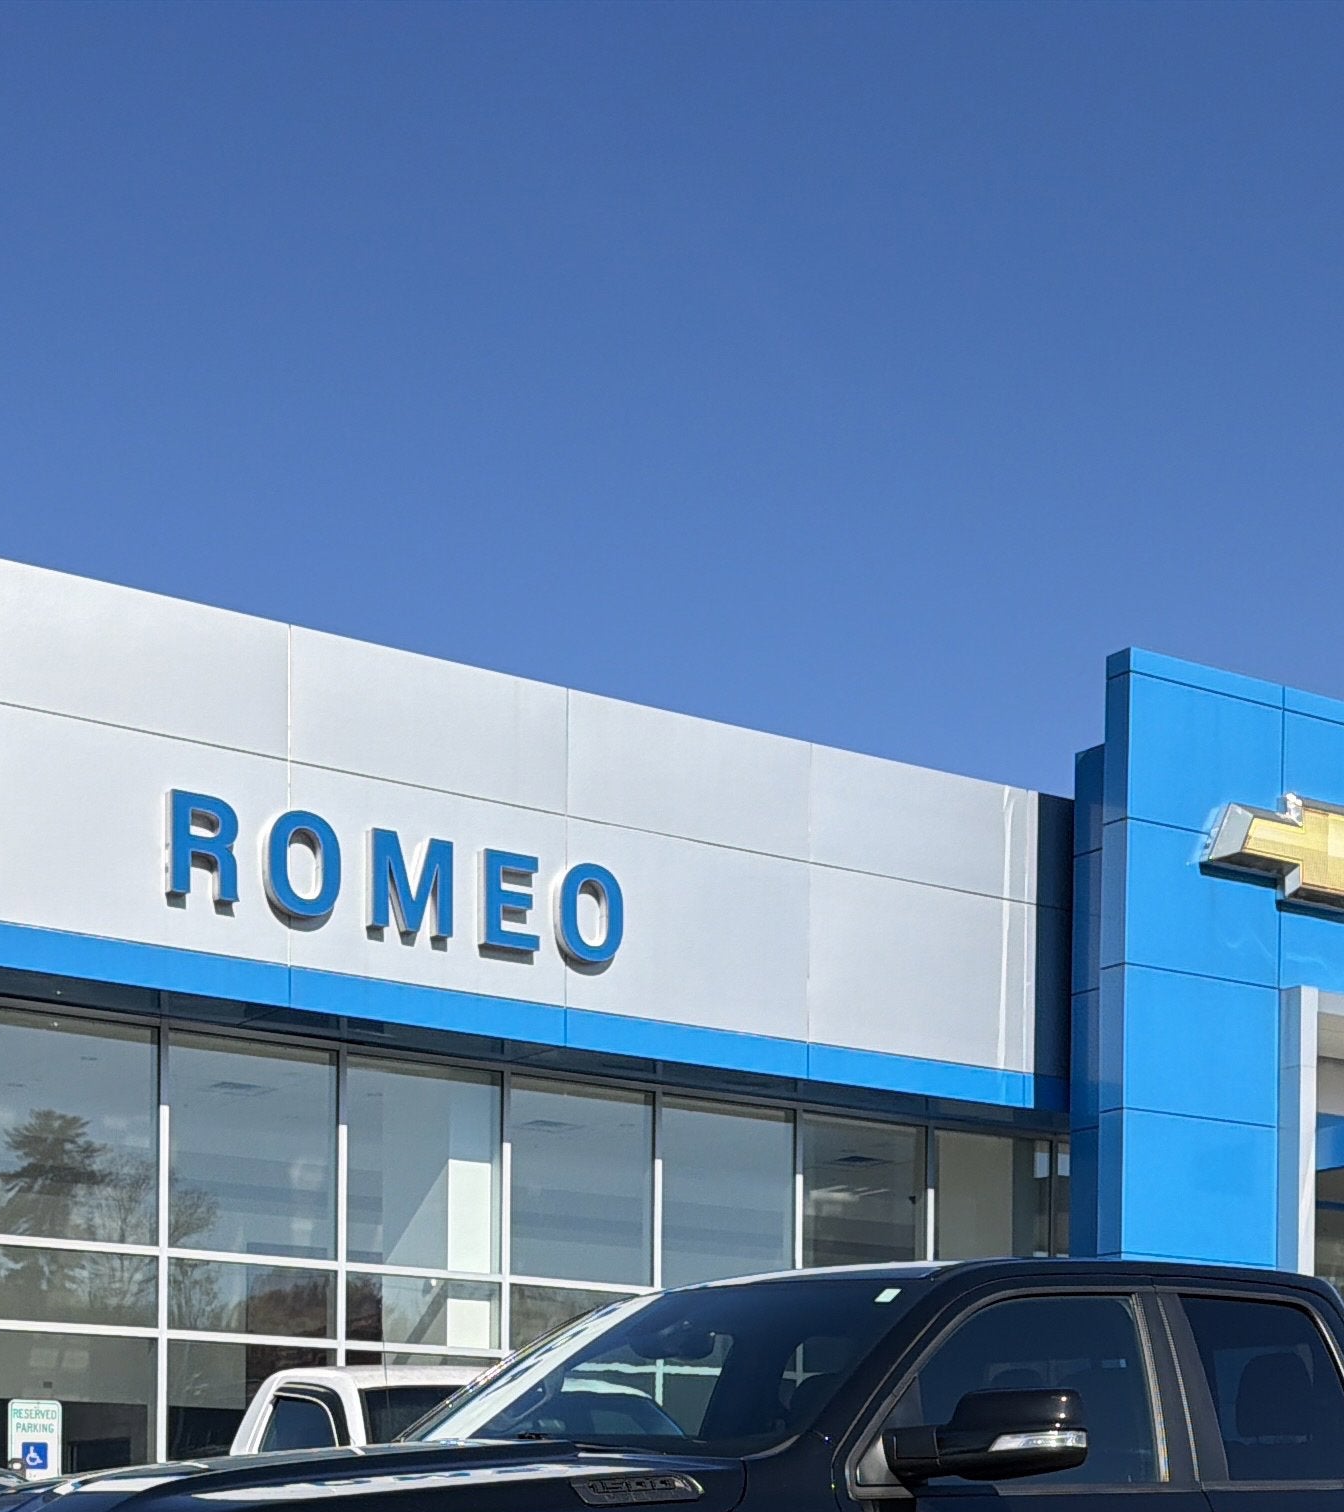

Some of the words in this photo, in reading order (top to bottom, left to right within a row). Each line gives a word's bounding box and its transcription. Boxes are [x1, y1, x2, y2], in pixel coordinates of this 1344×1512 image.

[165, 788, 624, 964] ROMEO
[13, 1408, 57, 1420] RESERVED
[16, 1421, 55, 1434] PARKING
[587, 1475, 677, 1495] 1500
